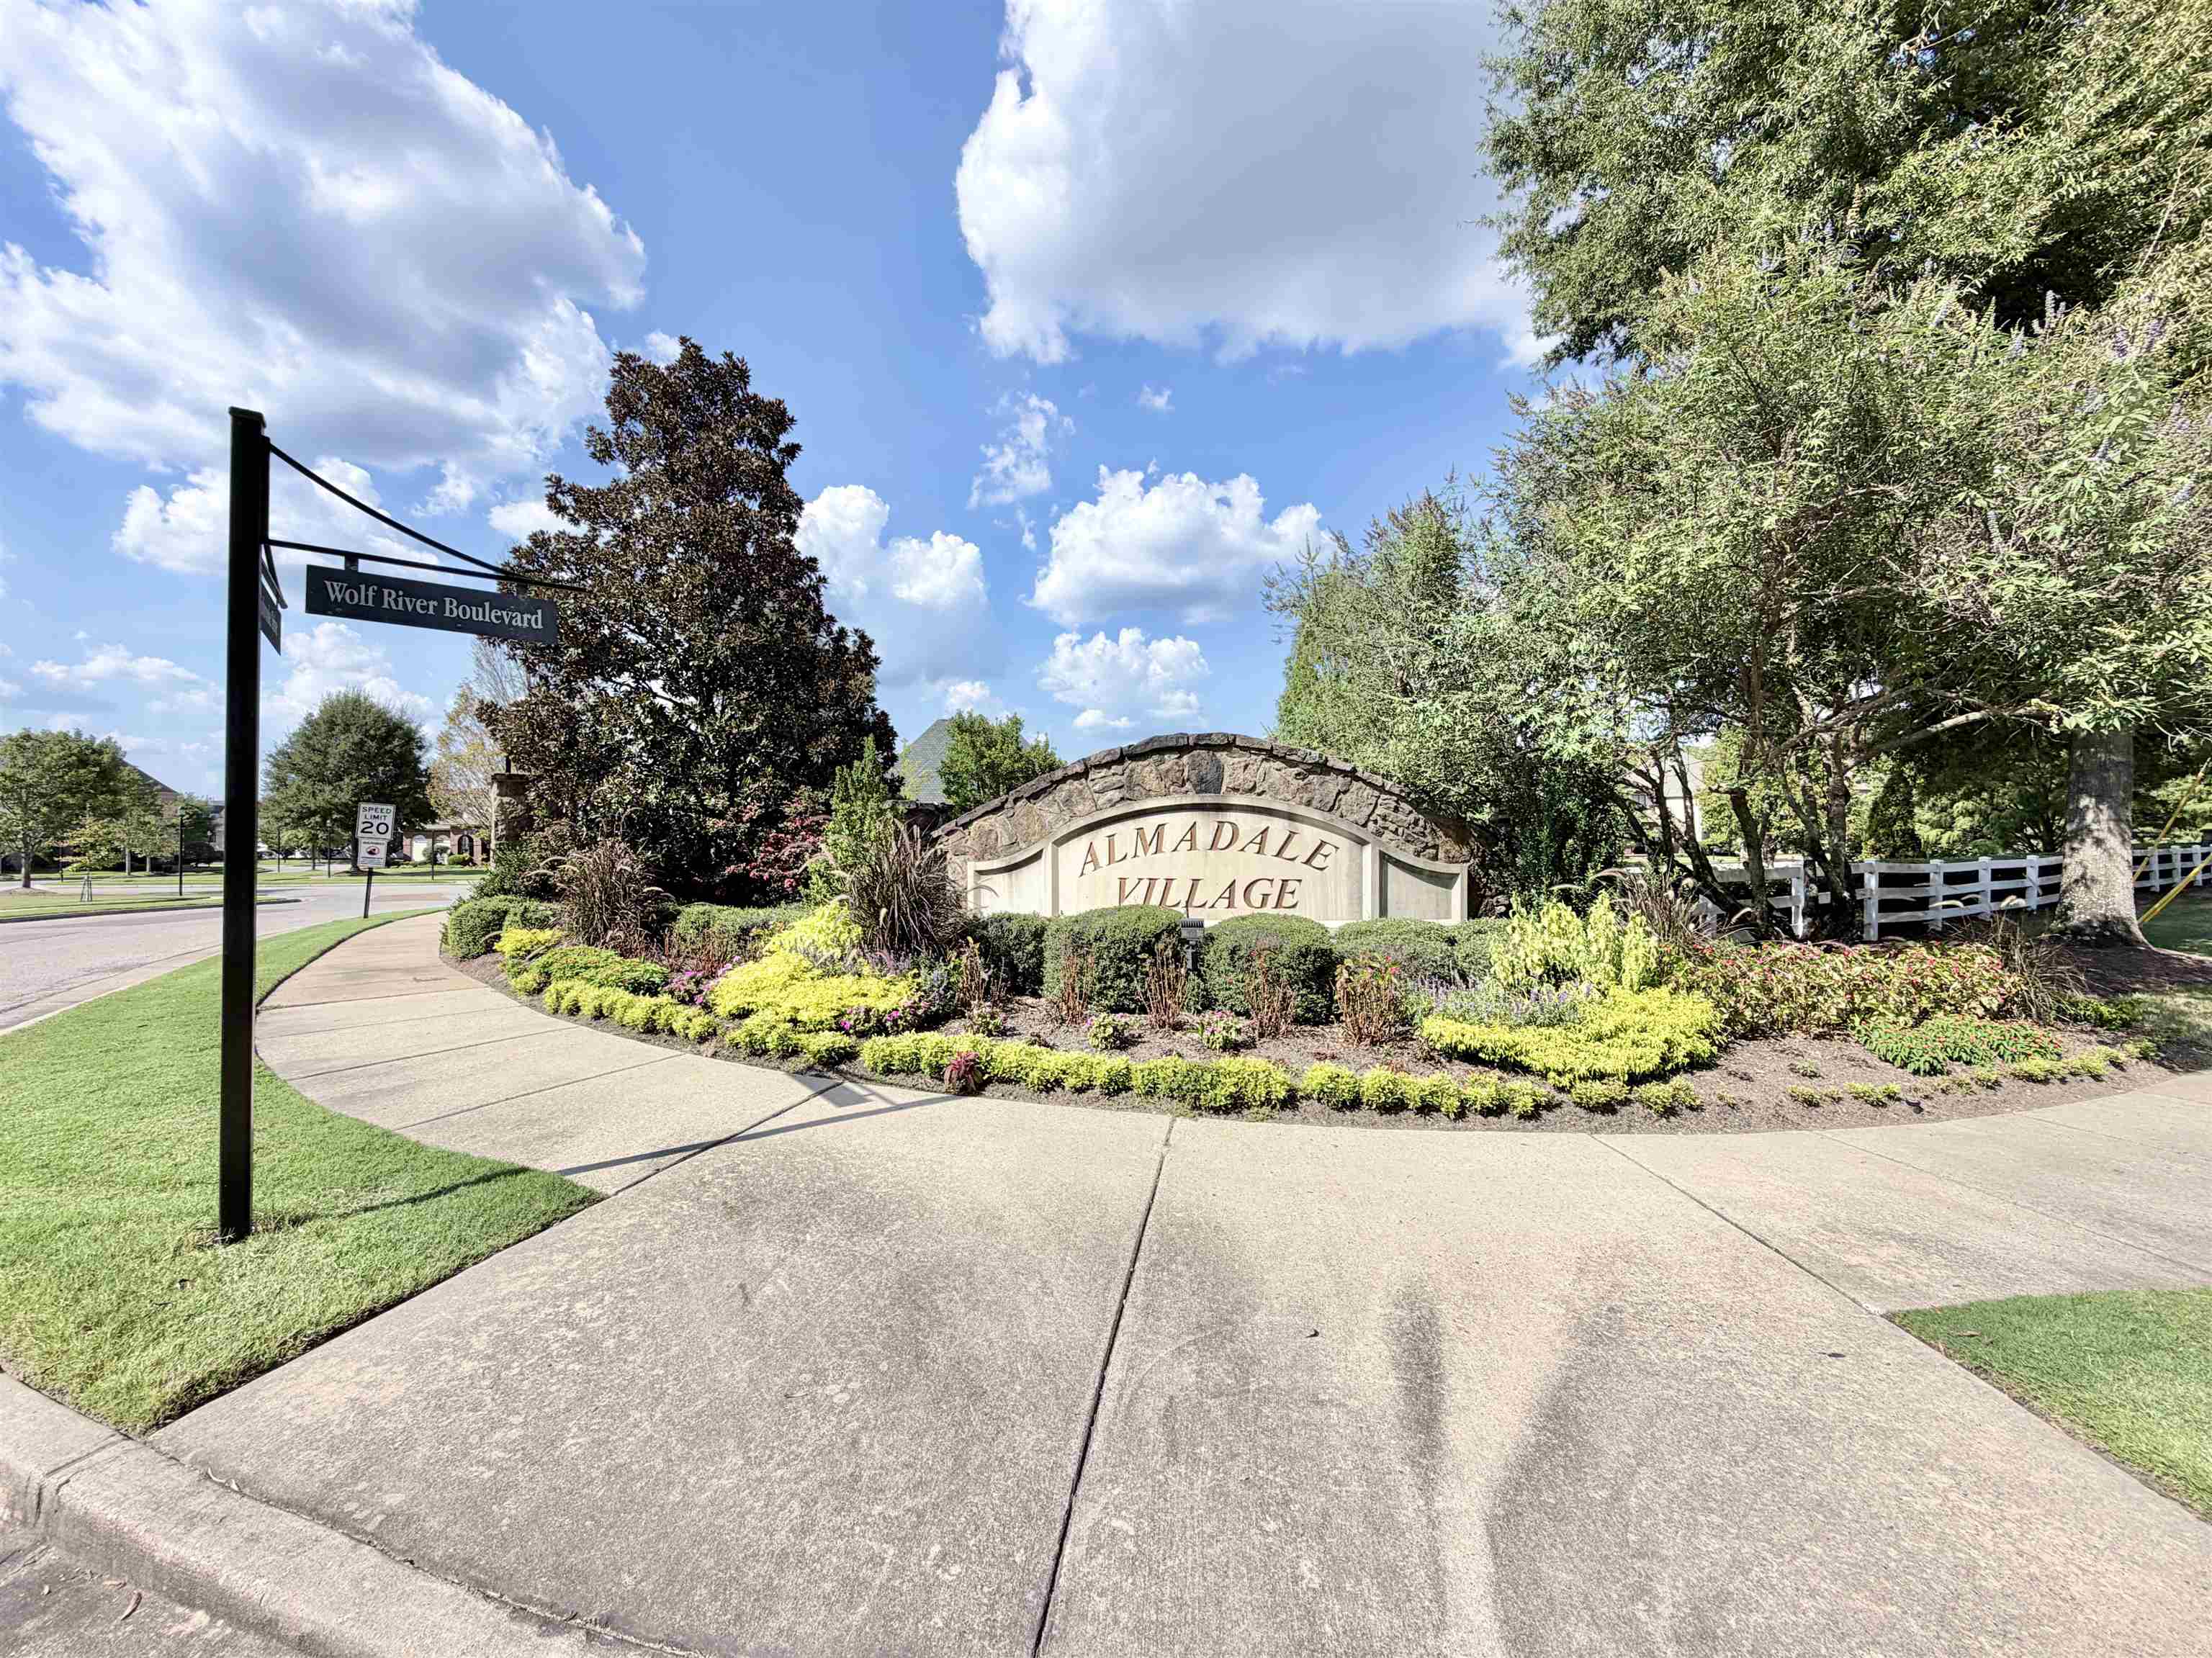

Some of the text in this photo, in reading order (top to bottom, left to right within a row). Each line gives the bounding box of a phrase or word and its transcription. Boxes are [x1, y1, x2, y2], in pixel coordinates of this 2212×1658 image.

[324, 580, 544, 629] Wolf River Boulevard
[361, 821, 389, 834] 20
[1079, 820, 1339, 877] ALMADALE
[1118, 878, 1303, 909] VILLAGE
